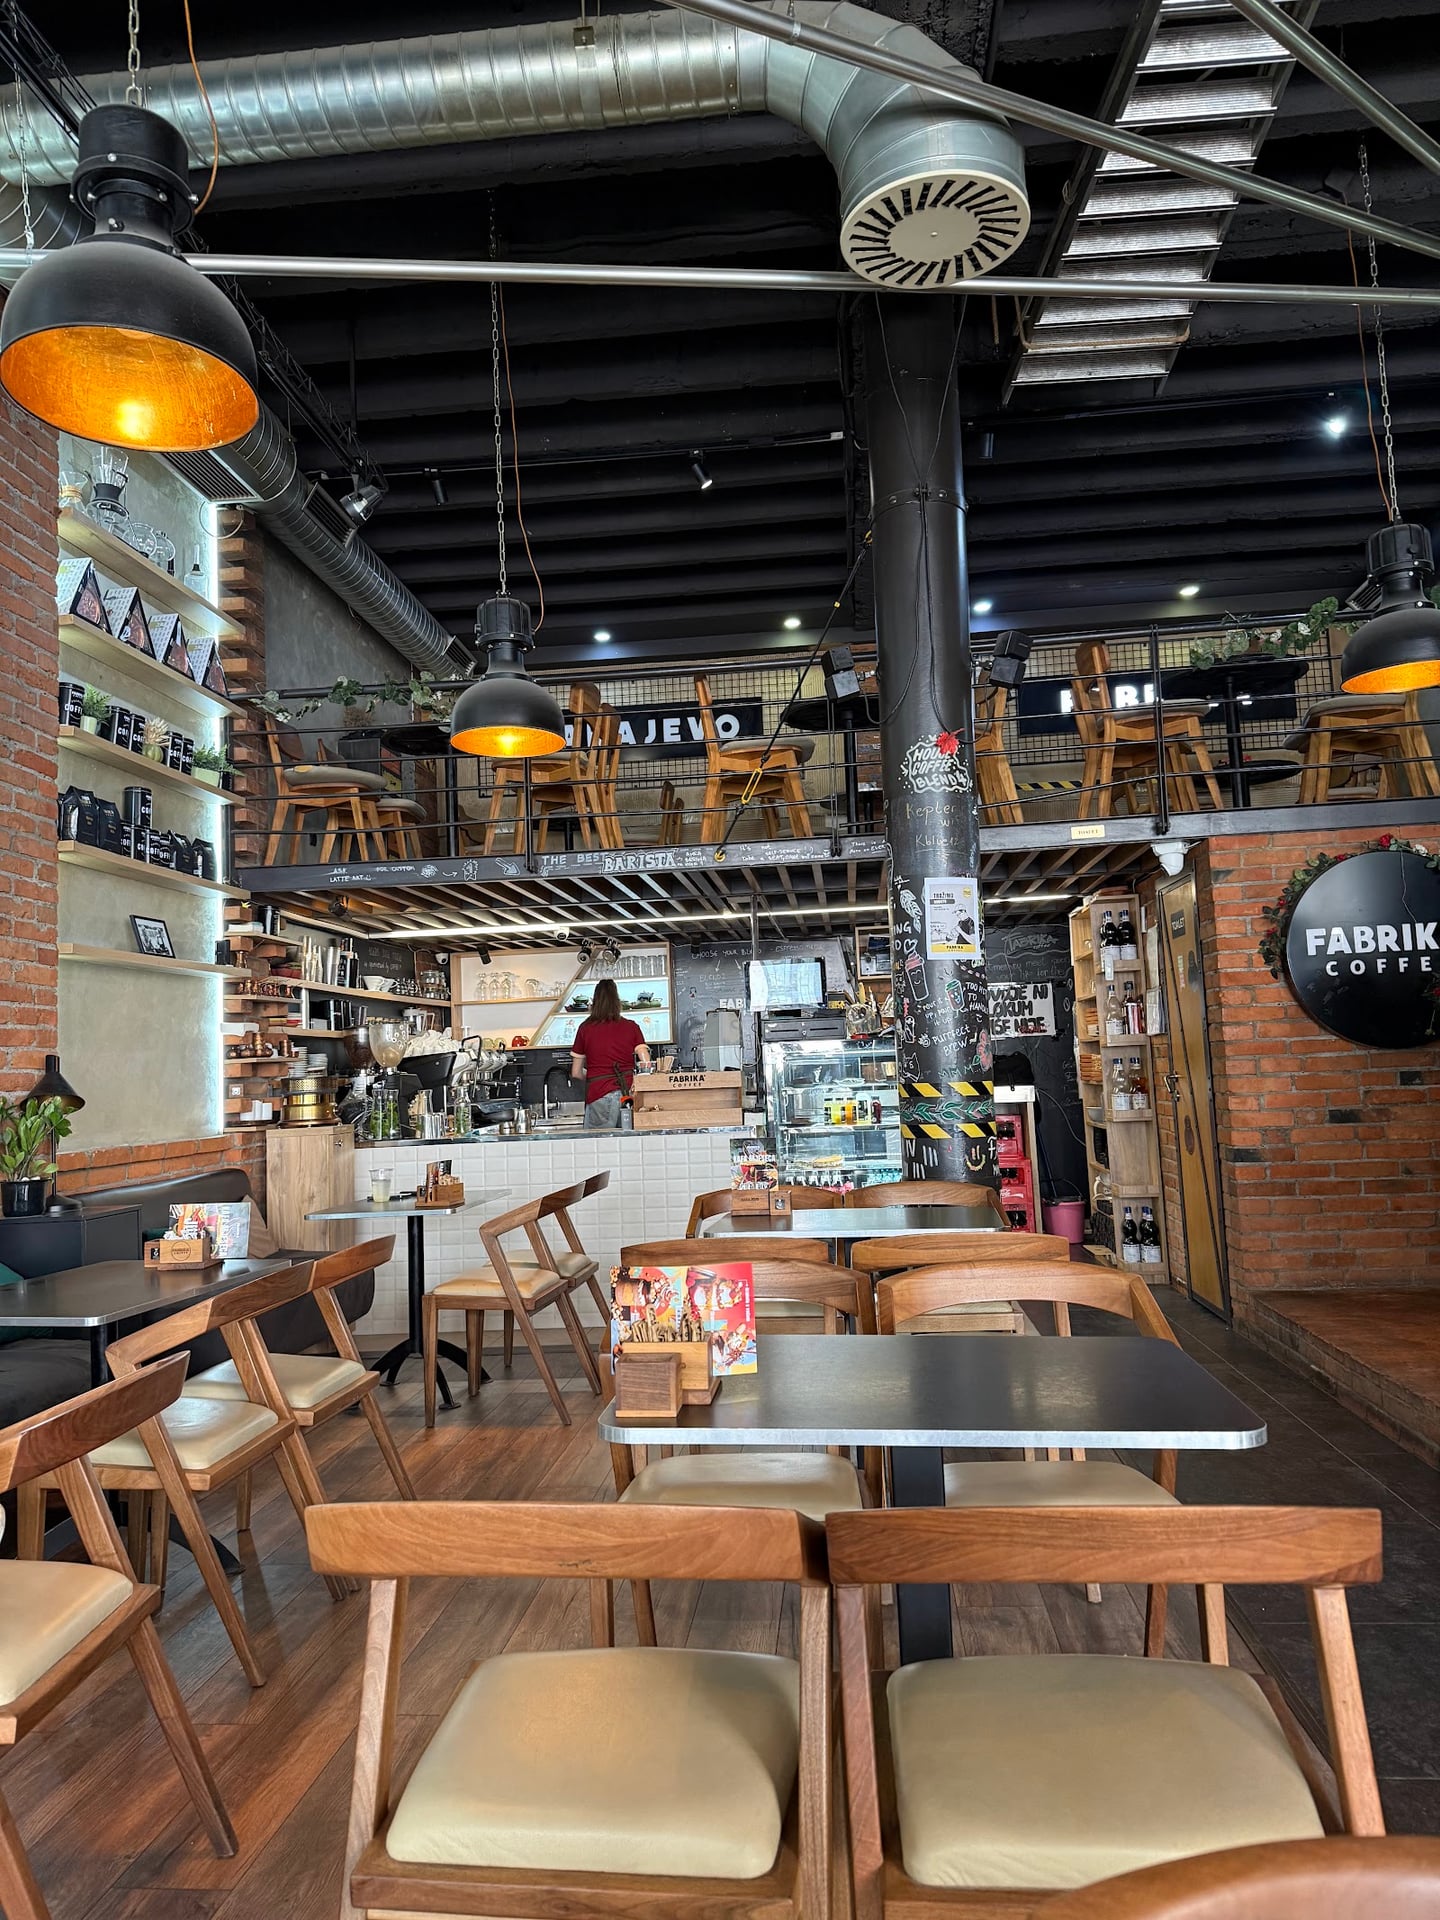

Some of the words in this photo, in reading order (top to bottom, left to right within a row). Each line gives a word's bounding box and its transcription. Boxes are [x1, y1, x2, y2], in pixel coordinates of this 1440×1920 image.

[912, 759, 954, 776] COFFEE
[916, 773, 957, 789] BLEND
[541, 854, 566, 865] THE
[602, 850, 678, 874] BARISTA
[1305, 921, 1440, 956] FABRIK
[691, 950, 718, 960] CHOOSE
[1325, 956, 1432, 977] COFFE
[966, 982, 978, 991] TOO
[968, 993, 977, 1001] TO
[668, 1075, 705, 1083] FABRIKA
